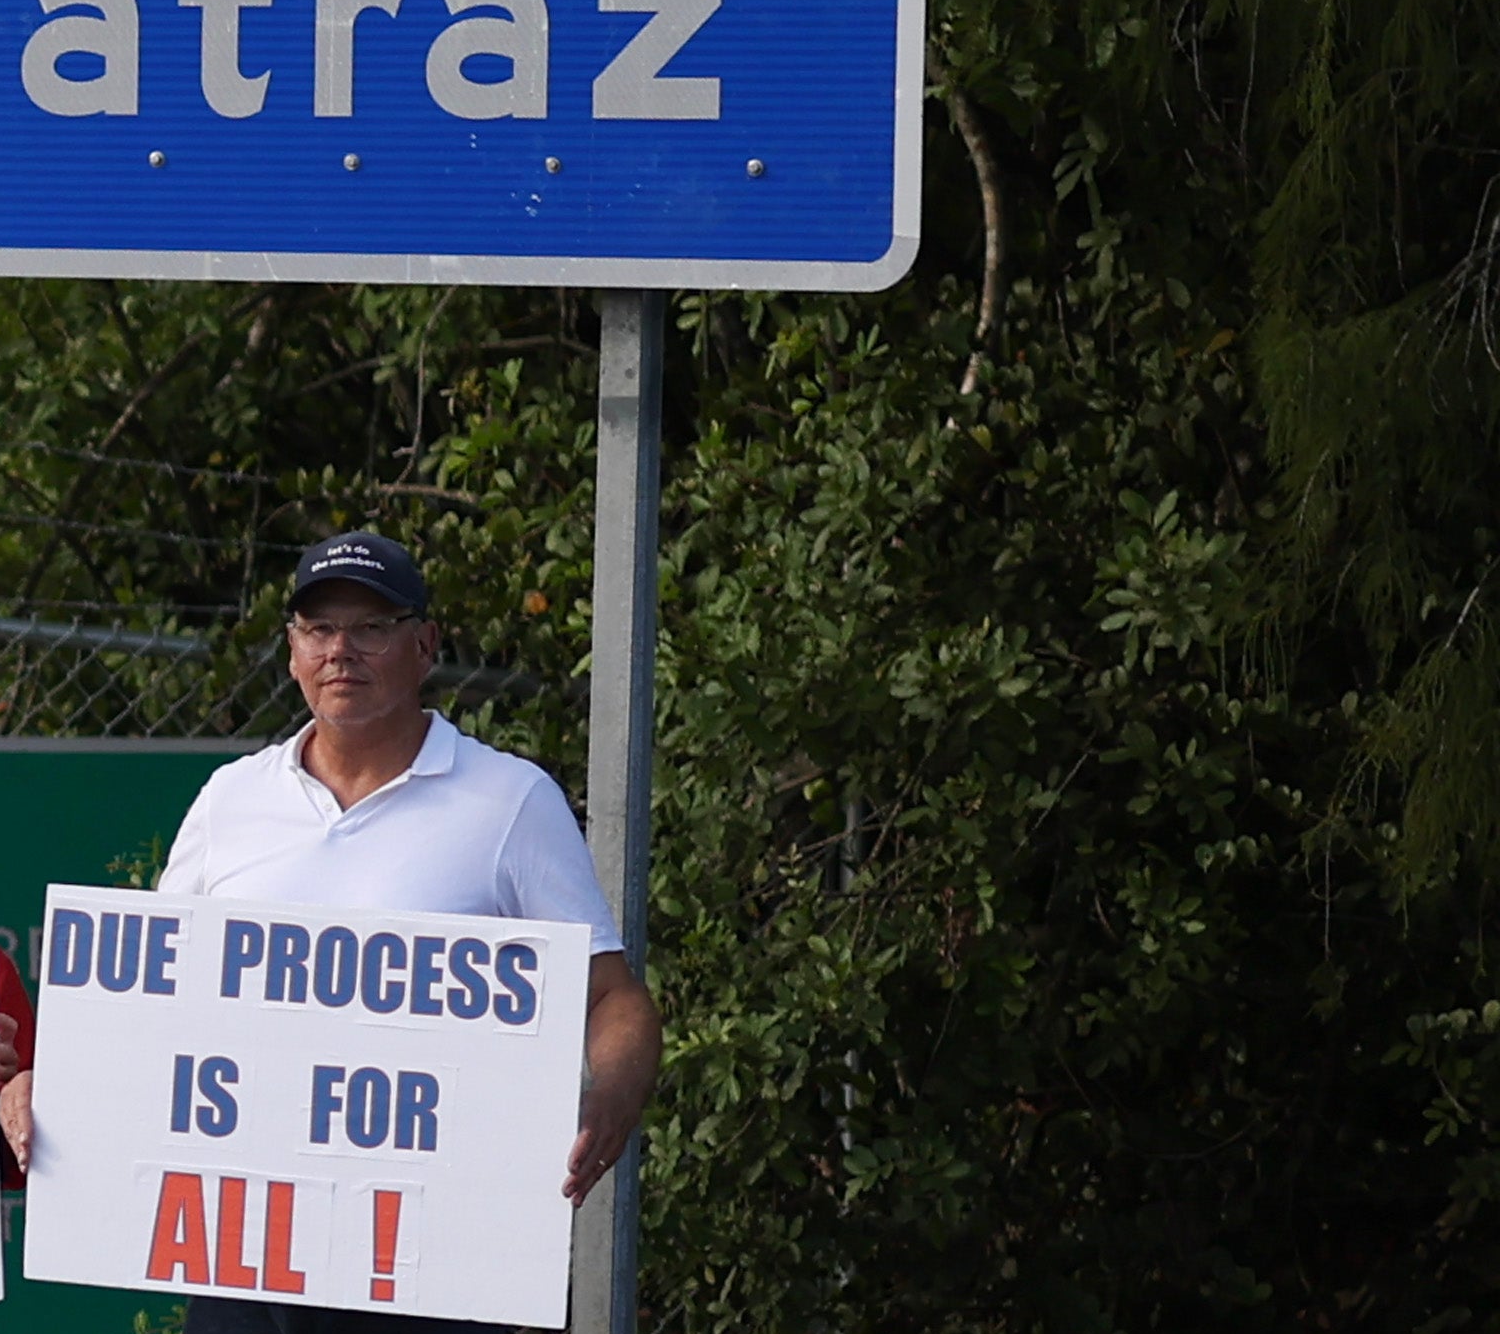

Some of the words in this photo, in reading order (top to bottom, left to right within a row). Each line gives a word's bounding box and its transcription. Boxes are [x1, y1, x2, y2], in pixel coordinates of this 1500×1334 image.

[354, 545, 370, 556] do
[47, 907, 180, 996] DUE
[219, 919, 539, 1026] PROCESS
[170, 1053, 240, 1137] IS
[309, 1064, 440, 1152] FOR
[144, 1170, 306, 1295] ALL
